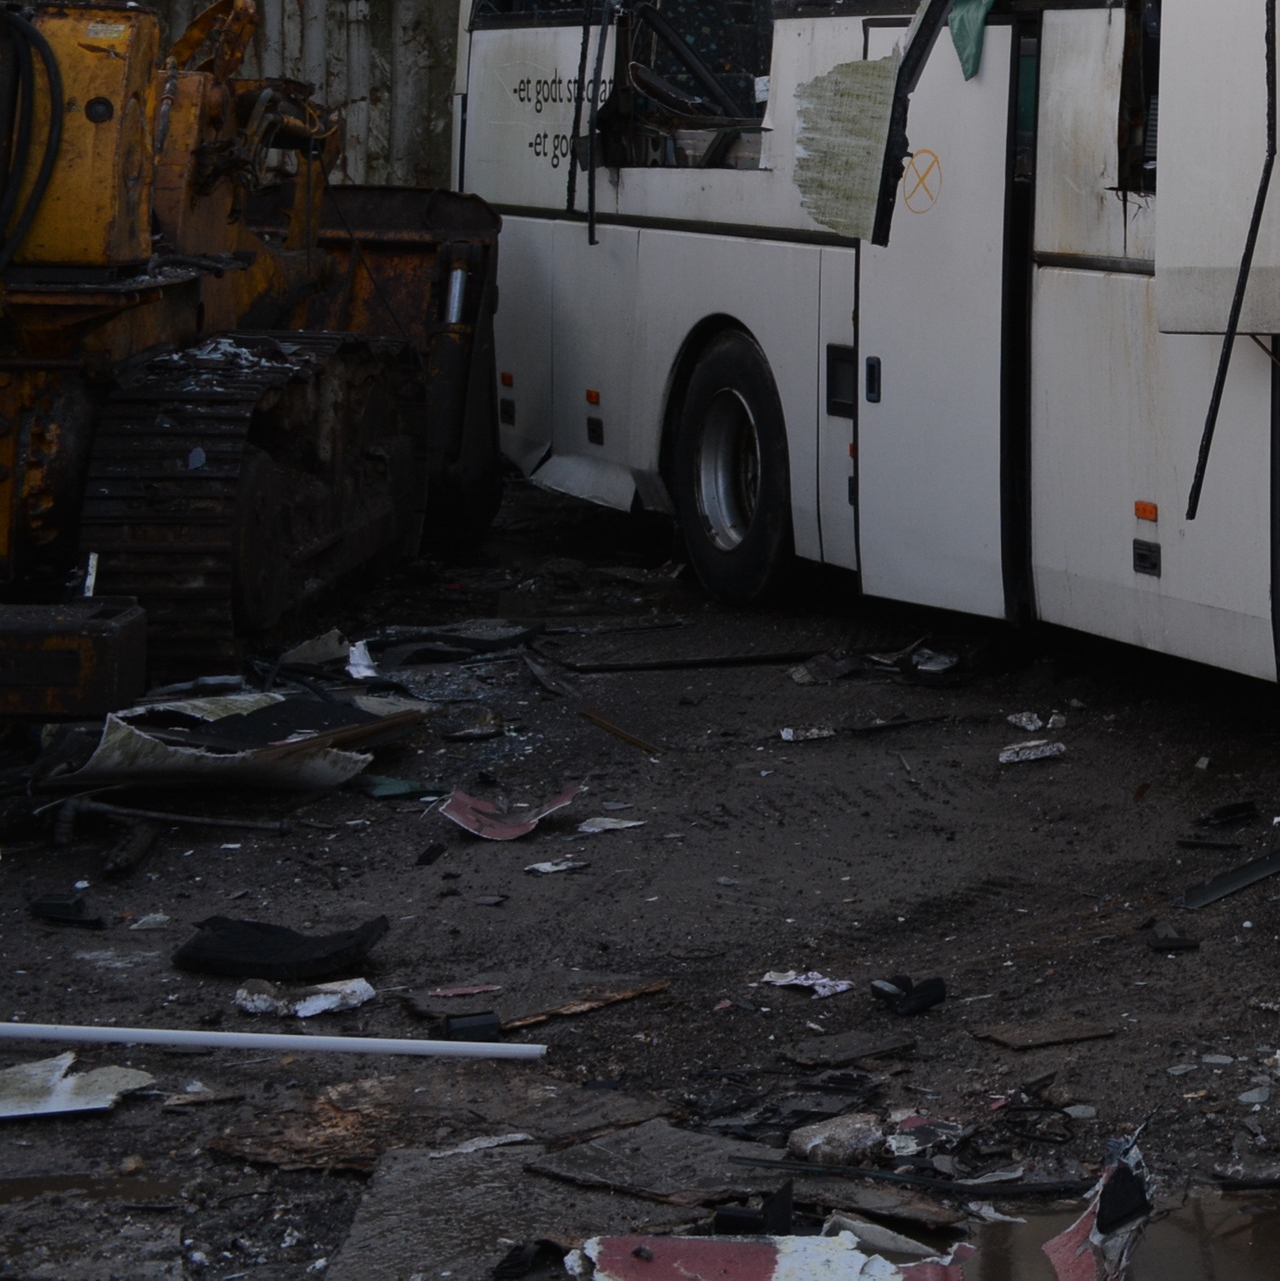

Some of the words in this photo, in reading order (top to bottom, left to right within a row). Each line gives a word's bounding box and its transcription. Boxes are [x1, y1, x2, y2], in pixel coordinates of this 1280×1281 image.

[513, 77, 531, 103] -et
[535, 68, 563, 113] godt
[528, 130, 548, 157] -et
[551, 133, 574, 169] go
